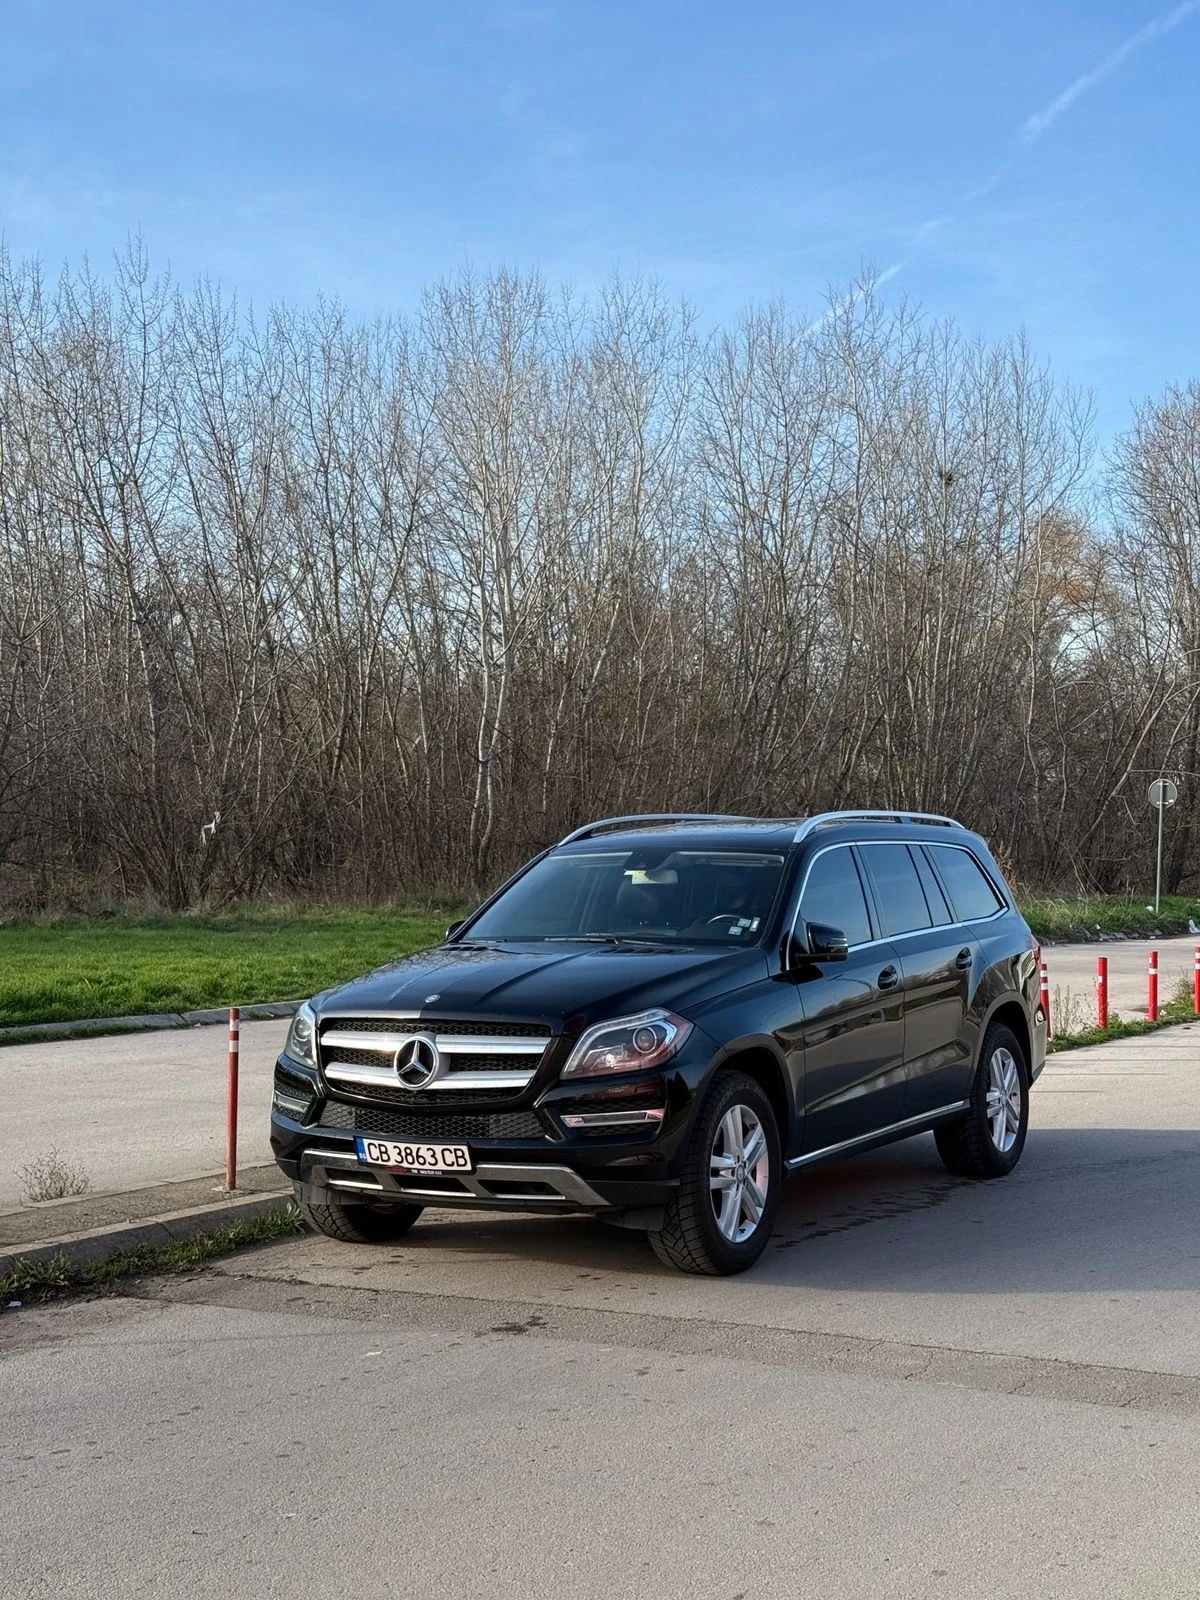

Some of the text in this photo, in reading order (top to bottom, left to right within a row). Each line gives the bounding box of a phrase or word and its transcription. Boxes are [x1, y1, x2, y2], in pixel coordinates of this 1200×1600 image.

[367, 1142, 467, 1167] CB 3863 CB
